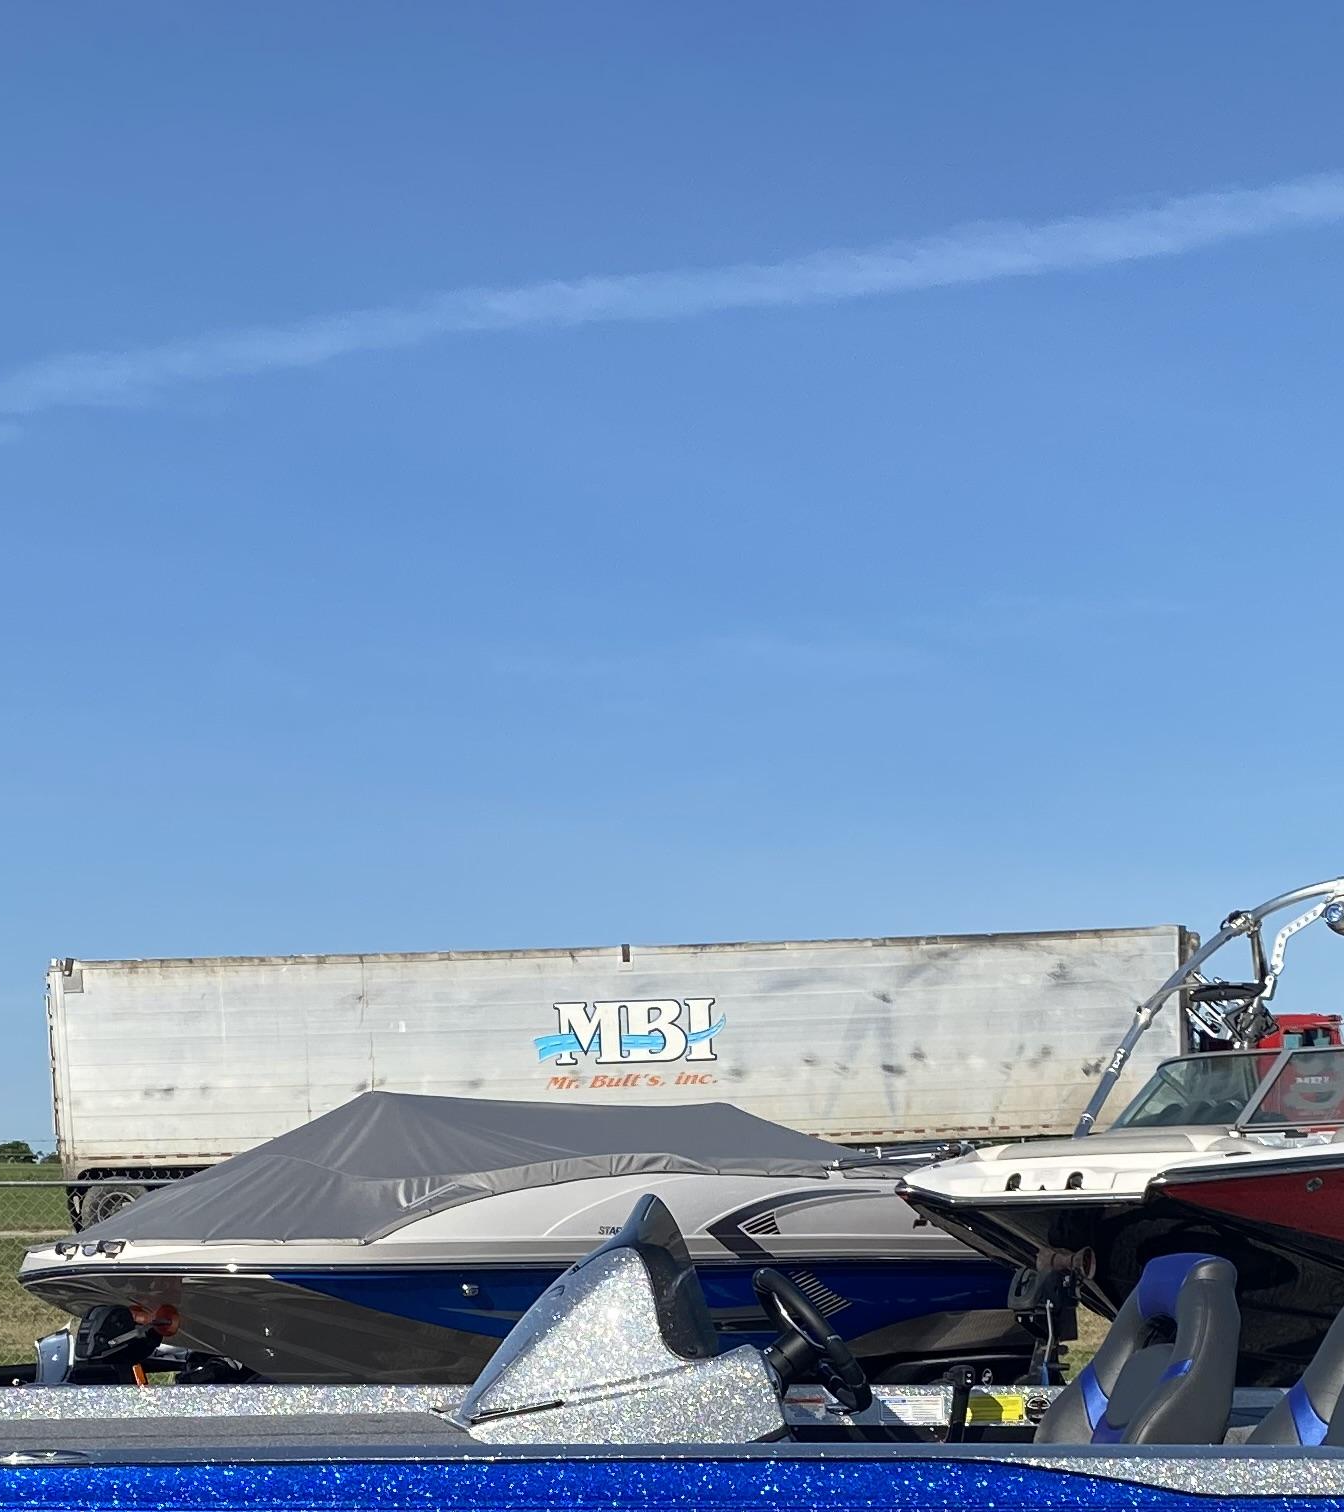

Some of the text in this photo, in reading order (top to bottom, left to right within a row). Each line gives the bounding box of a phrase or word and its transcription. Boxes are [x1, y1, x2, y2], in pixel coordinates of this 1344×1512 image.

[553, 997, 718, 1066] MBI
[548, 1076, 579, 1090] Mr.
[674, 1070, 718, 1086] inc.
